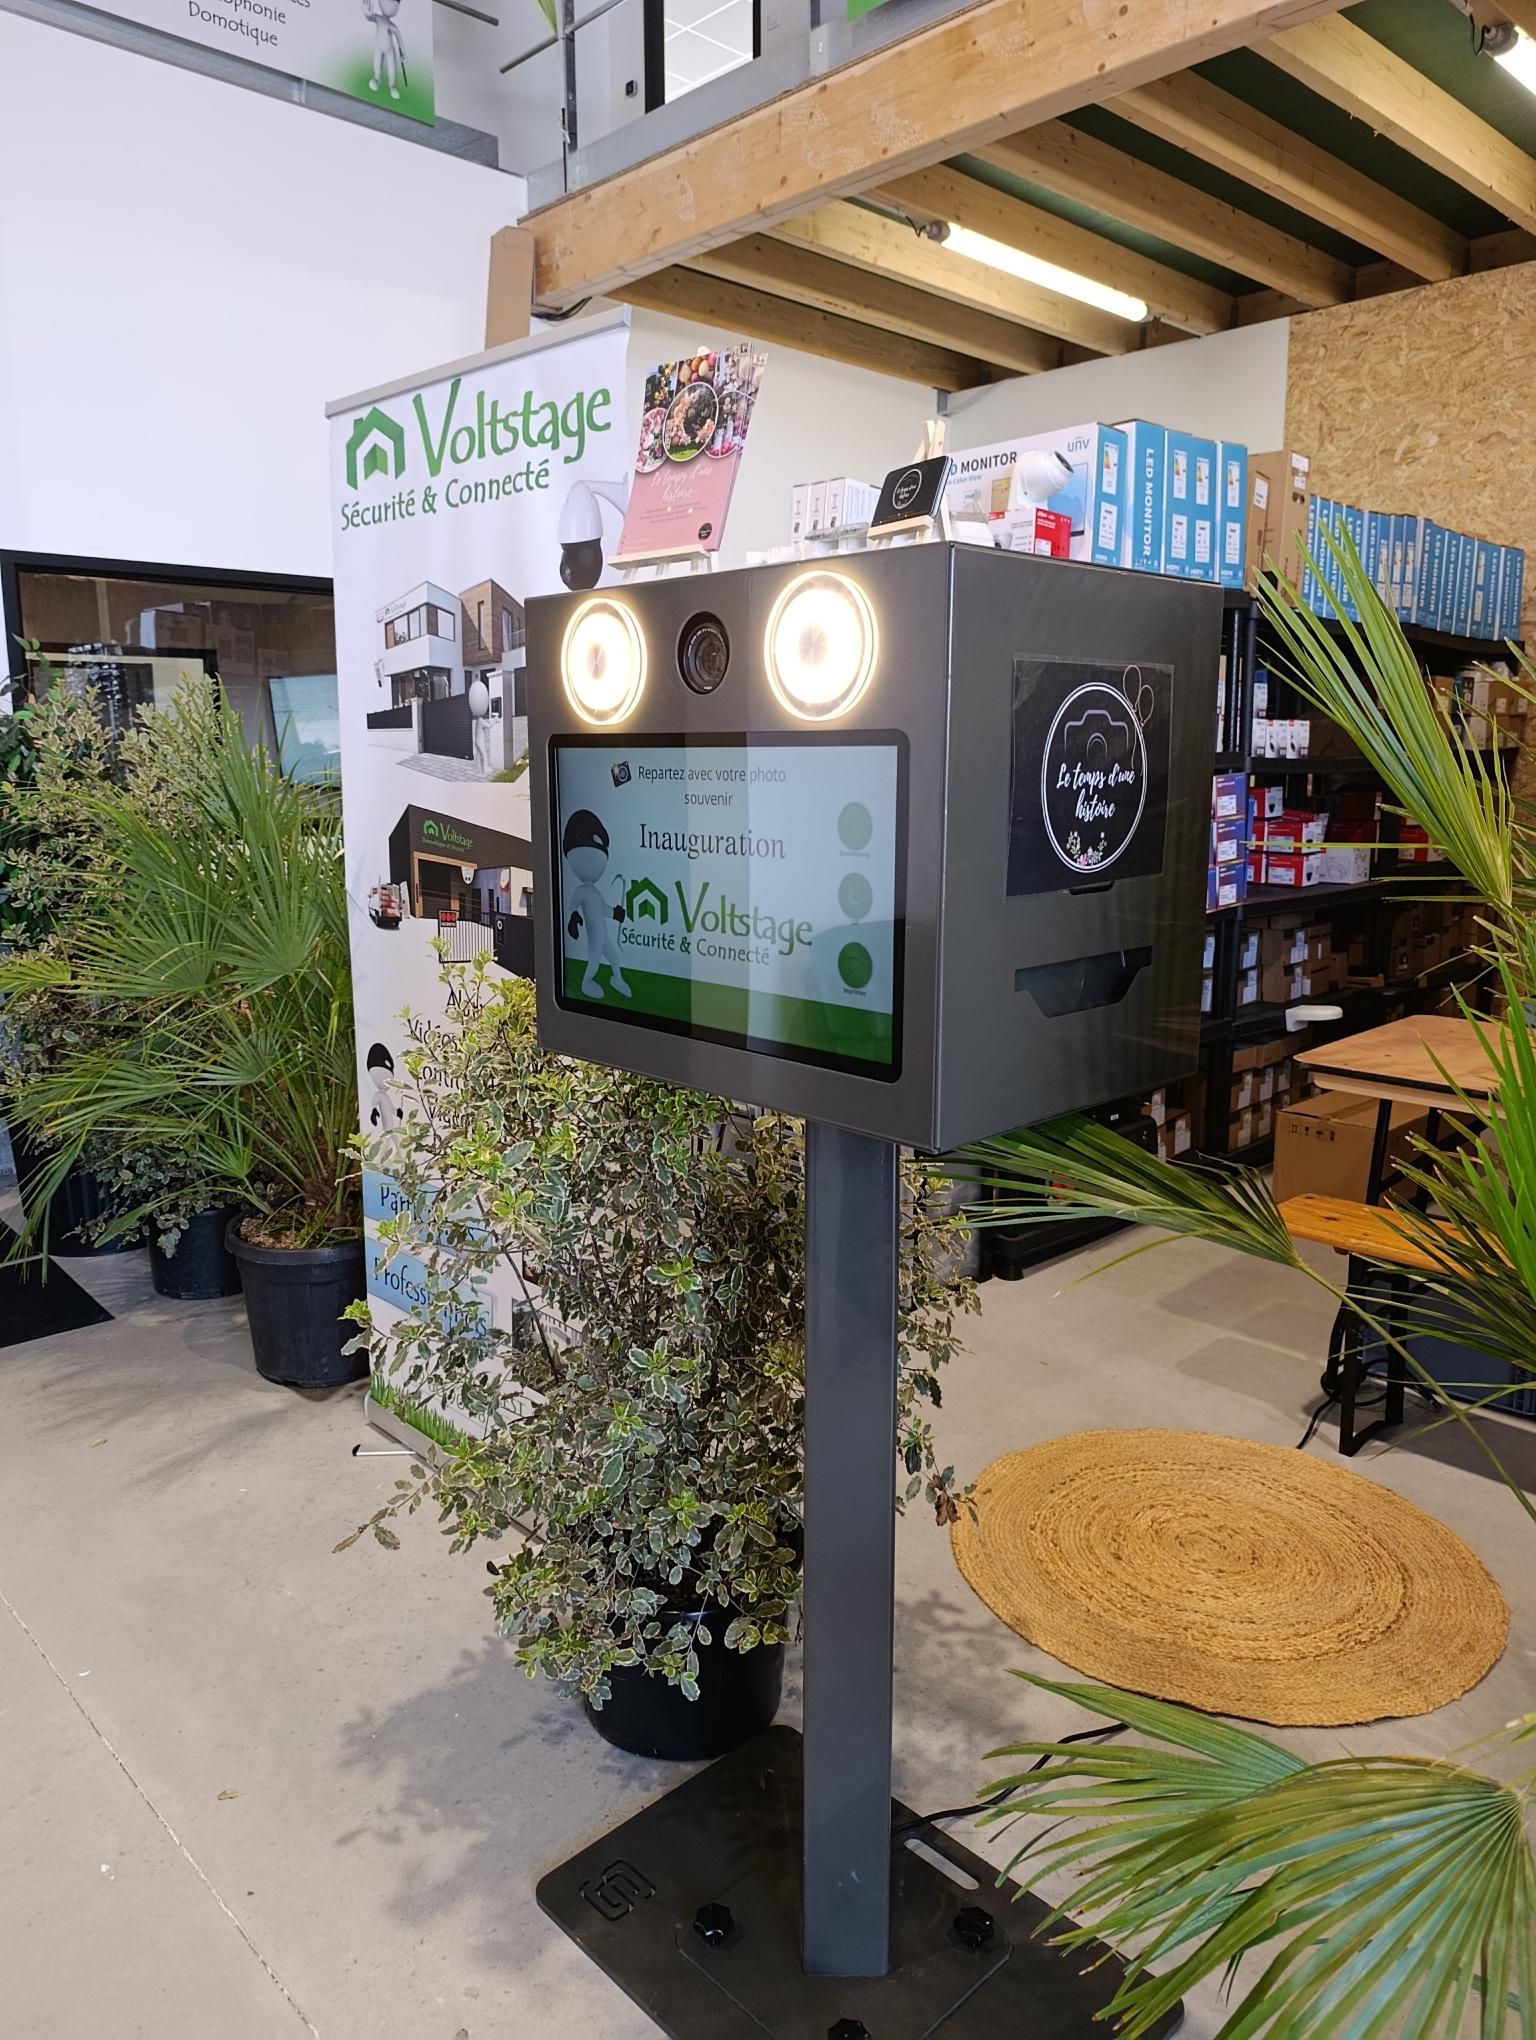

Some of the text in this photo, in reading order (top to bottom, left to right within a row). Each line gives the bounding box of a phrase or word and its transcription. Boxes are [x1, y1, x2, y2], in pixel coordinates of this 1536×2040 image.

[188, 1, 278, 46] Domotique
[412, 377, 611, 477] Voltstage
[960, 451, 1017, 474] MONITOR
[341, 459, 550, 531] Sécurité & Connecté
[1142, 448, 1154, 556] LED MONITOR
[1303, 533, 1313, 594] MOITOR
[1419, 553, 1428, 608] MONITOR
[1429, 559, 1439, 612] MONITOR
[1445, 564, 1454, 616] MONITOR
[1460, 568, 1469, 620] MONITOR
[638, 766, 786, 785] Repartez avec votre photo
[684, 792, 733, 806] souvenir
[1056, 762, 1136, 796] Le temps d'une
[1075, 788, 1116, 822] histoire
[639, 823, 786, 860] Inauguration
[675, 880, 813, 956] Voltstage
[622, 927, 770, 966] Sécurité & Connecté
